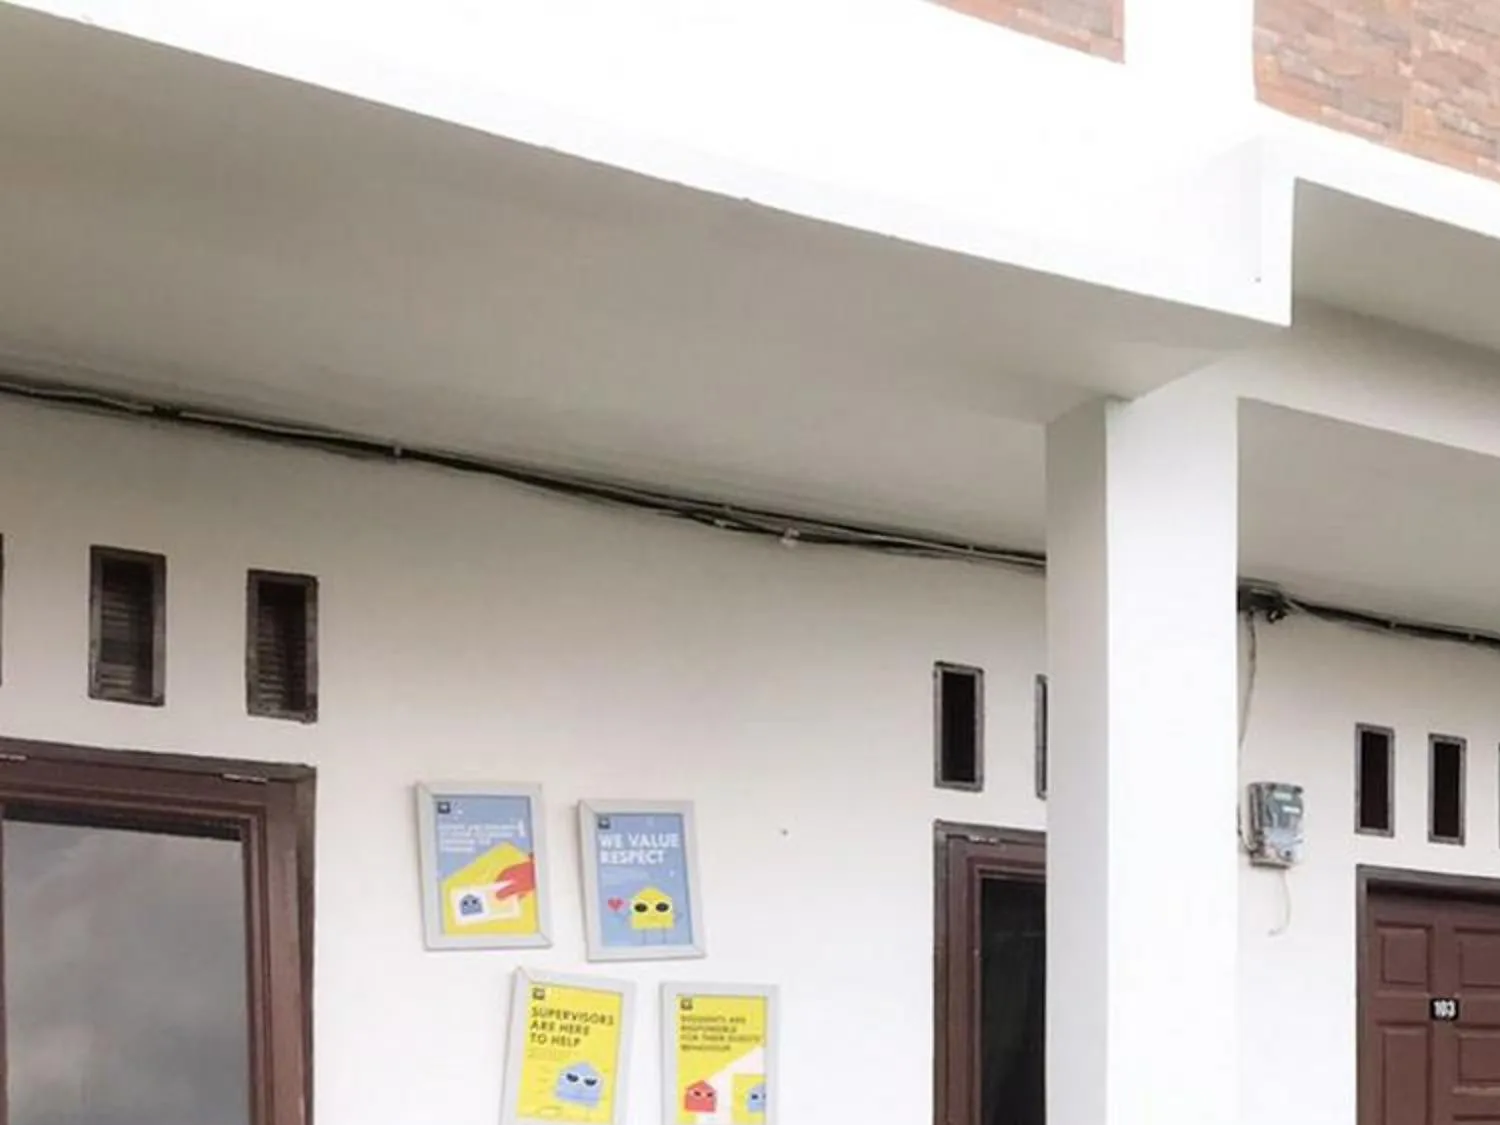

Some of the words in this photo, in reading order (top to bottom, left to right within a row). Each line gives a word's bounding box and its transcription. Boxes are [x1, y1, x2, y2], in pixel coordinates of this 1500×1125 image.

[599, 832, 622, 849] WE
[627, 831, 679, 848] VALUE
[600, 849, 664, 865] RESPECT
[531, 1006, 614, 1026] SUPERVISORS
[530, 1020, 556, 1032] ARE
[559, 1024, 590, 1036] HERE
[530, 1032, 547, 1045] TO
[551, 1035, 581, 1048] HELP
